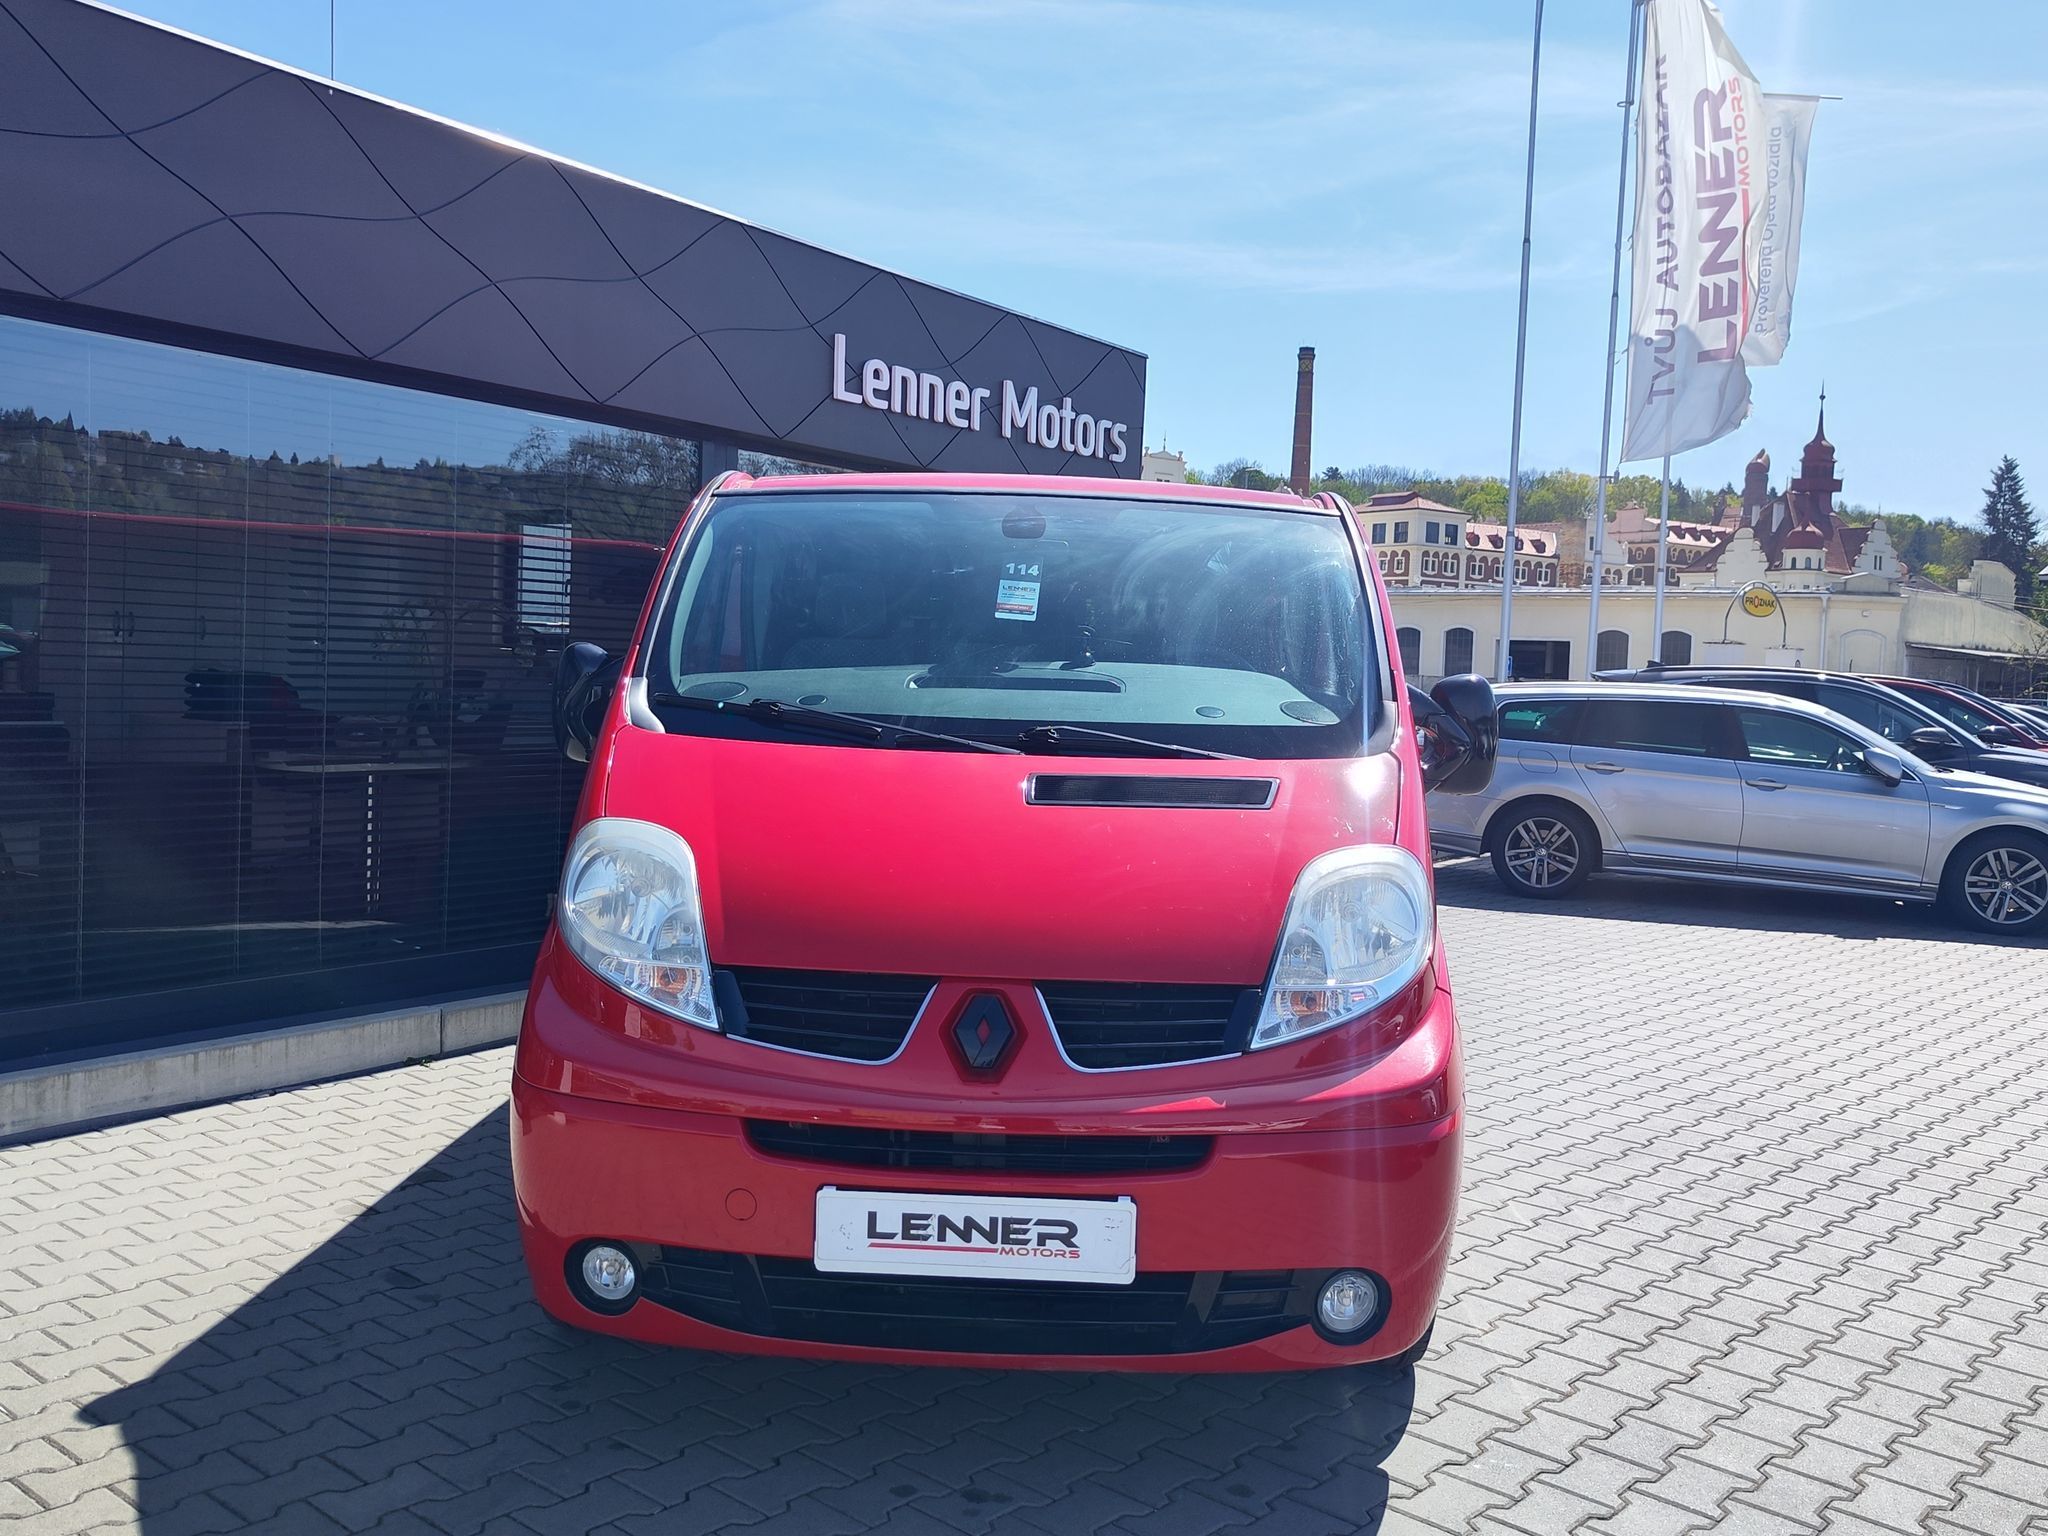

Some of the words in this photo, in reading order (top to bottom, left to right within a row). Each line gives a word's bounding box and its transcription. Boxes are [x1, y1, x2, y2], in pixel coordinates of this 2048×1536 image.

[1728, 76, 1750, 187] MOTORS
[1694, 79, 1739, 364] LENNER
[833, 333, 990, 431] Lenner
[1002, 379, 1128, 463] Motors
[1646, 308, 1679, 405] TVŮJ
[1006, 563, 1039, 576] 114
[867, 1210, 1080, 1249] LENNER
[999, 1246, 1080, 1259] MOTORS
